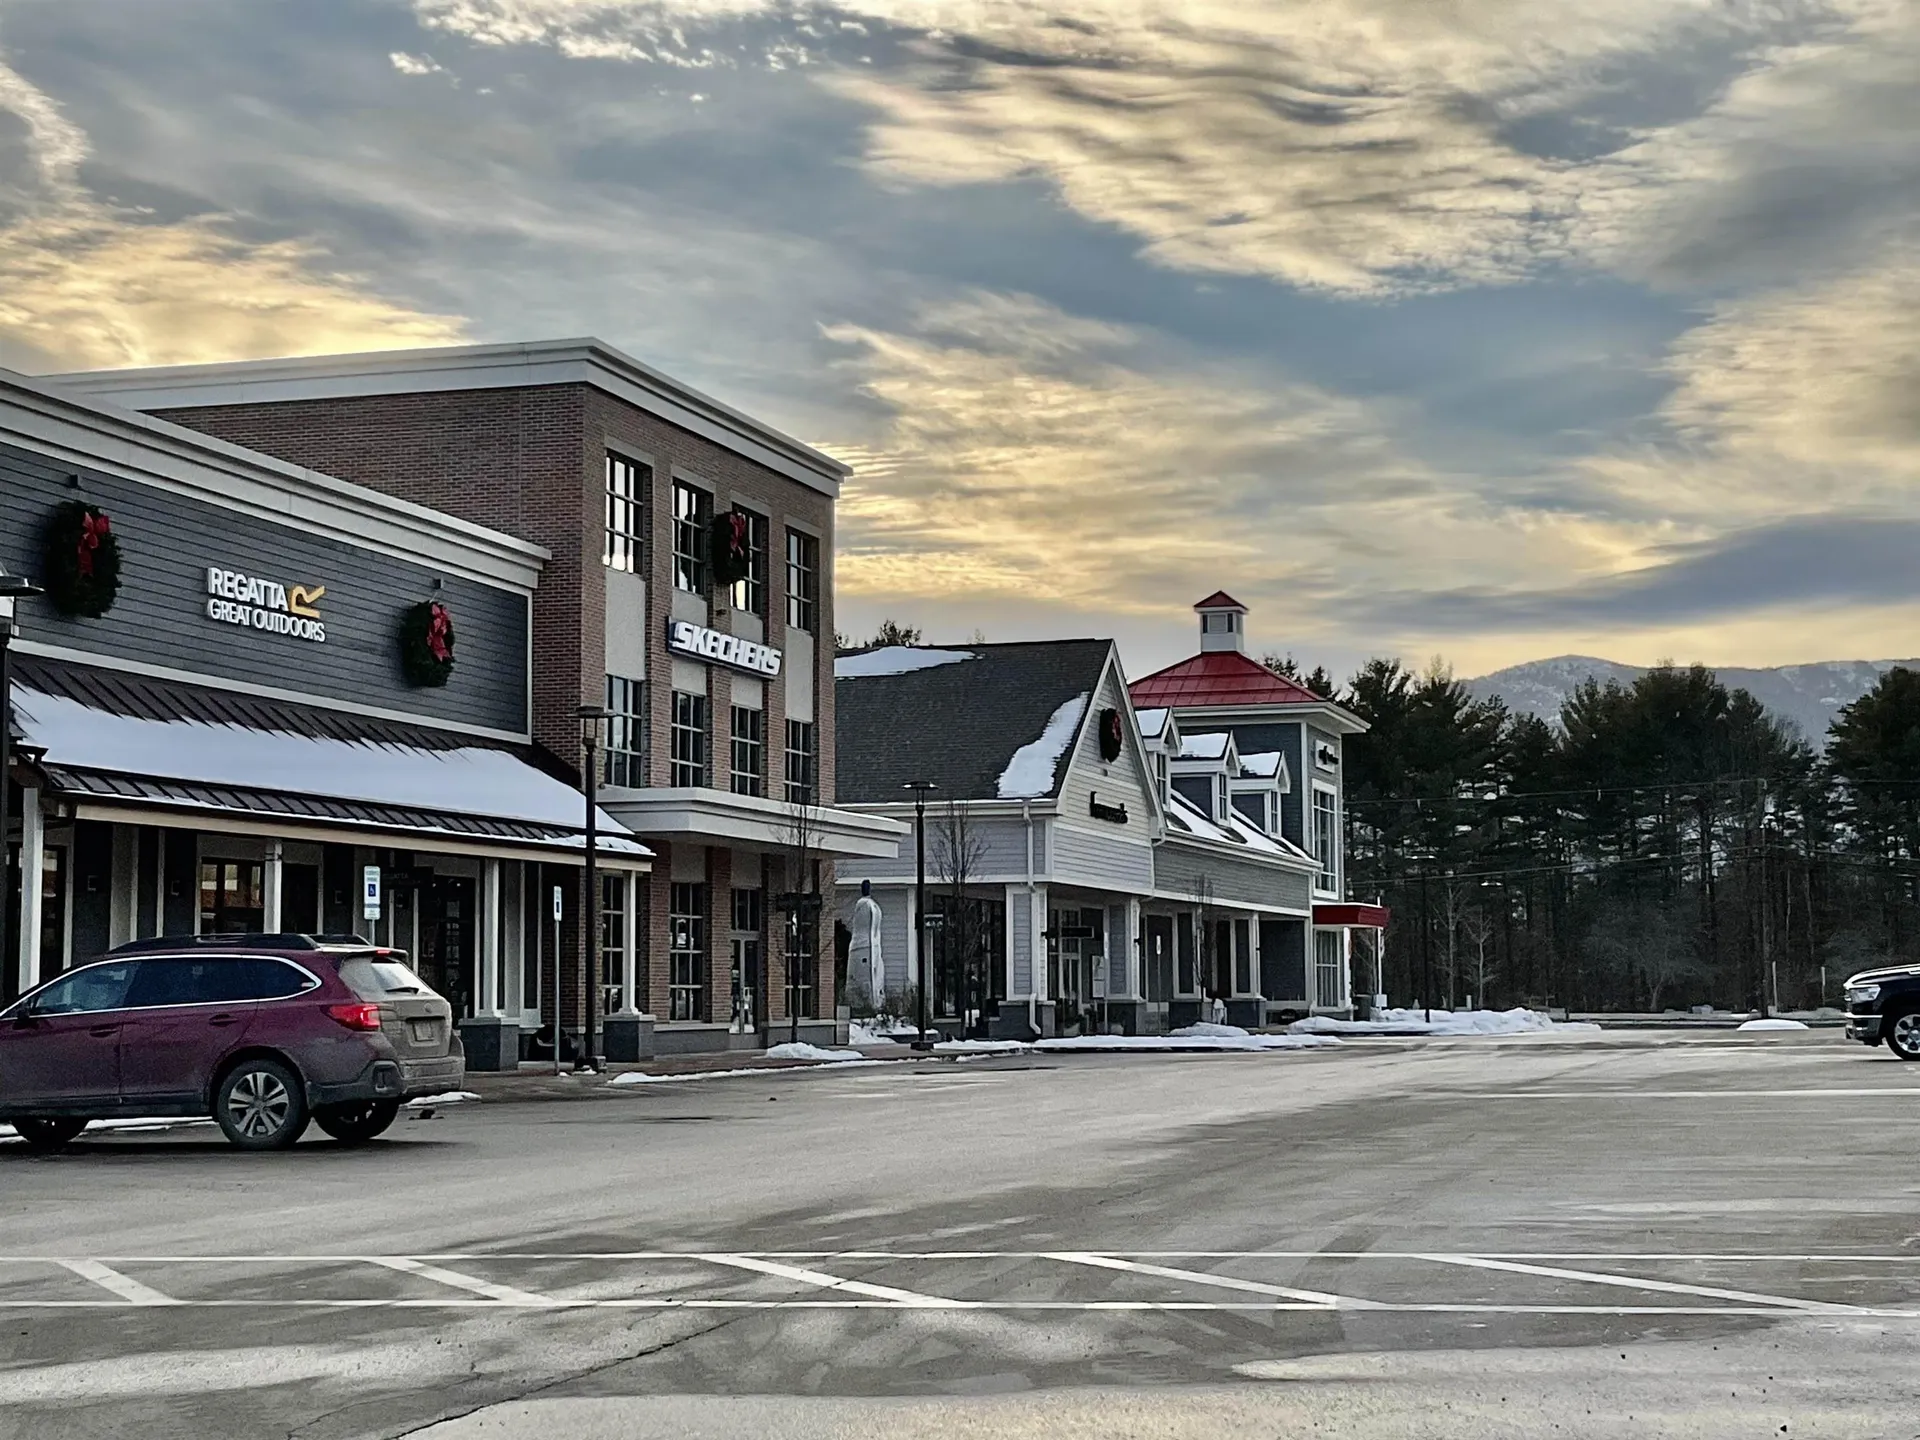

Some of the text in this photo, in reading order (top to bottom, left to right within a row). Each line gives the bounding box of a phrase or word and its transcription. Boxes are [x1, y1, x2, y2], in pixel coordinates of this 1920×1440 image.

[208, 567, 289, 612] REGATTA
[208, 599, 326, 642] GREAT OUTDOORS
[672, 621, 782, 675] SKECHERS
